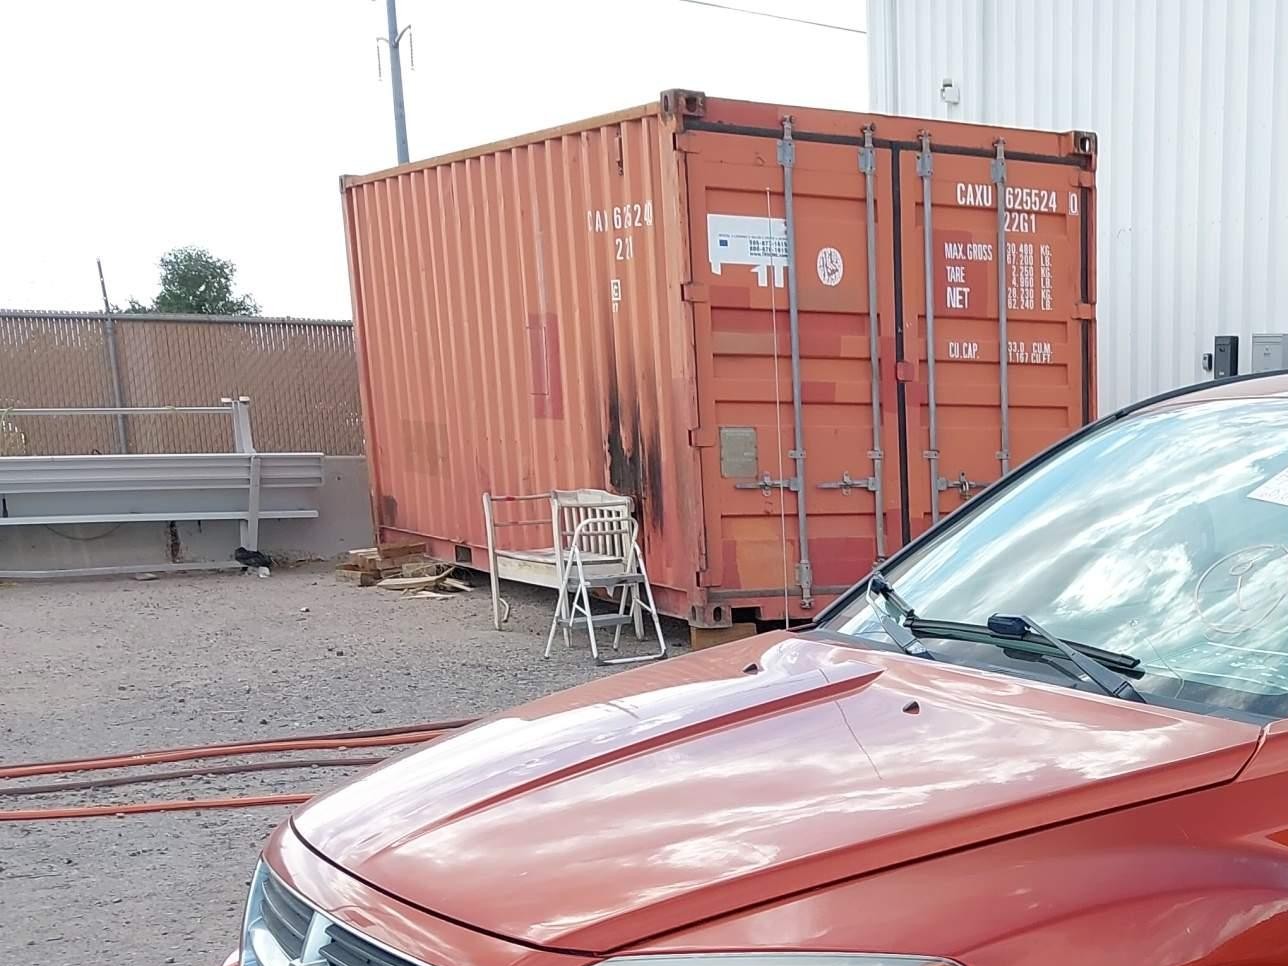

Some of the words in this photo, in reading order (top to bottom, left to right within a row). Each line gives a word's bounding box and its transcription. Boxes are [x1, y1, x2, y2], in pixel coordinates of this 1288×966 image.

[957, 183, 992, 207] CAXU
[1005, 187, 1057, 213] 625524
[1003, 211, 1036, 233] 22G1
[967, 244, 993, 261] GROSS
[946, 266, 965, 283] TARE
[946, 286, 970, 309] NET
